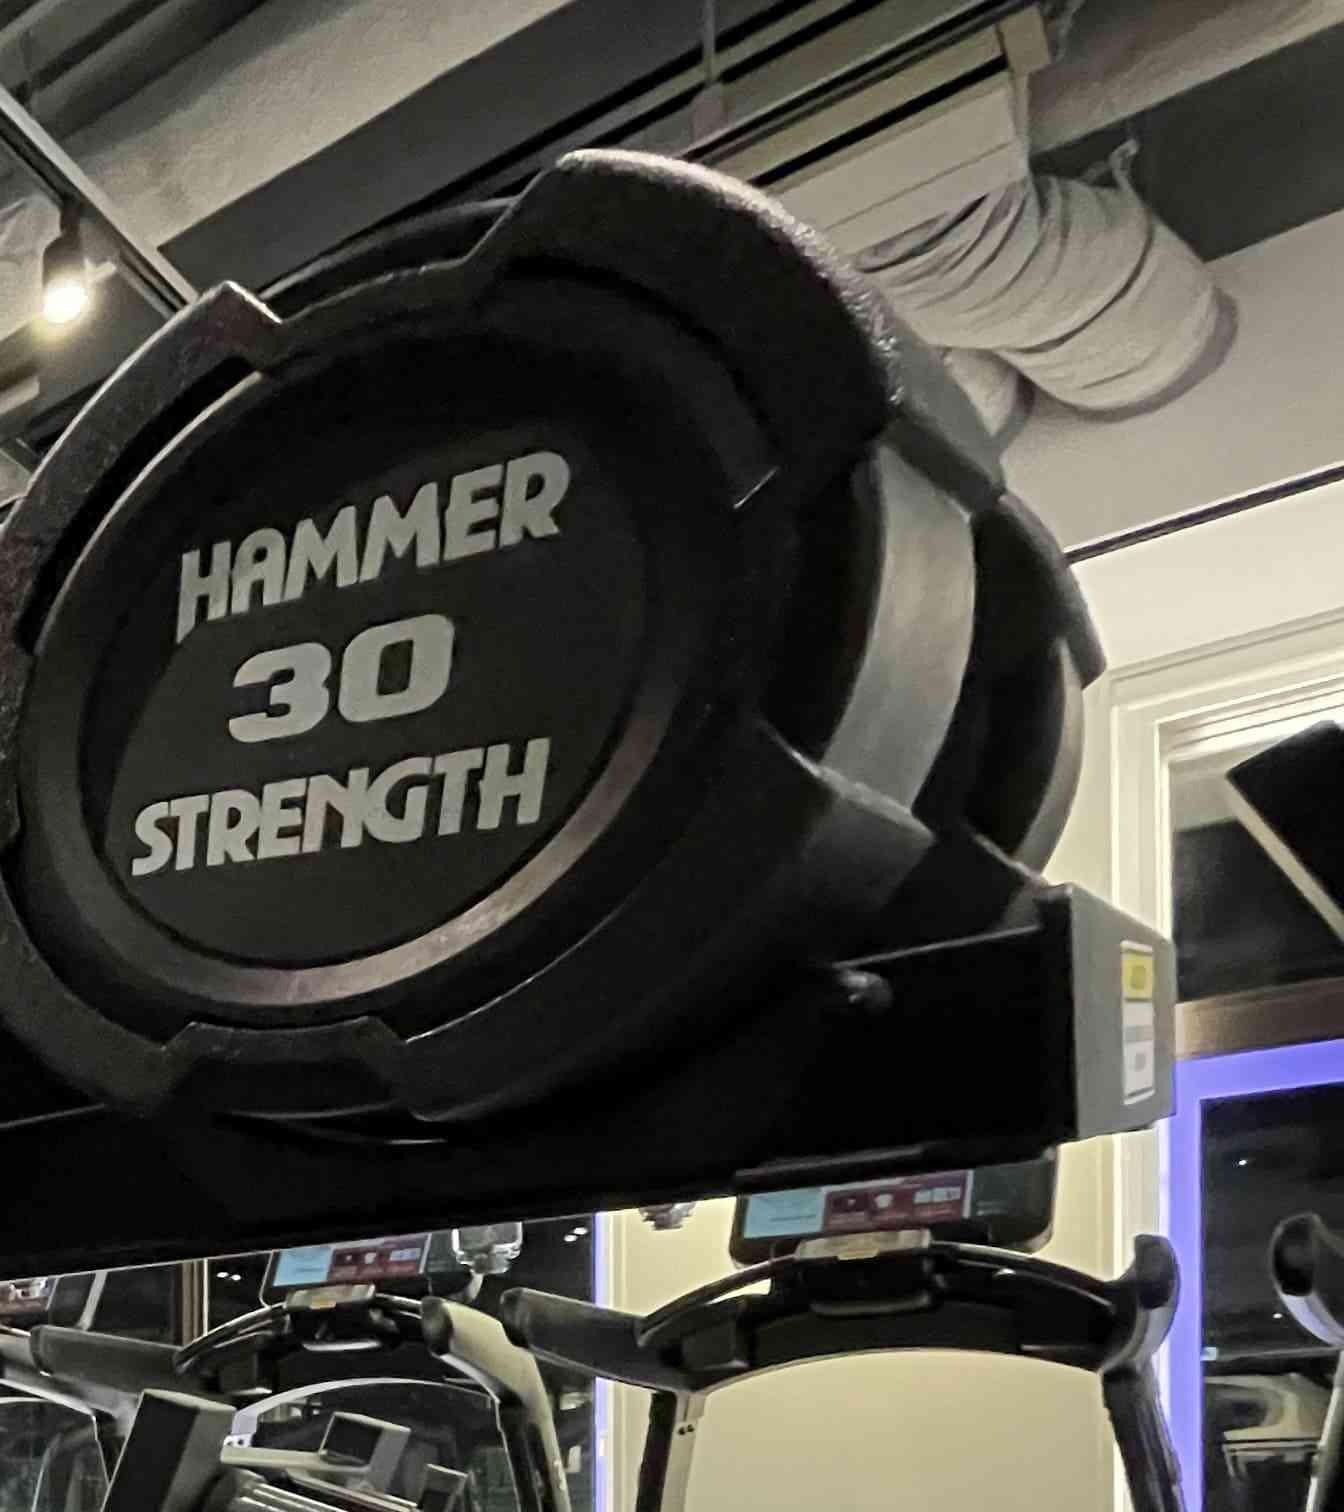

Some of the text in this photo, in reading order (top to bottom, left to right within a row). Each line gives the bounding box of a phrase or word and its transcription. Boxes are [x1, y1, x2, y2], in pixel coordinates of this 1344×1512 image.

[175, 450, 571, 645] HAMMER
[227, 613, 456, 745] 30
[130, 737, 552, 878] STRENGTH
